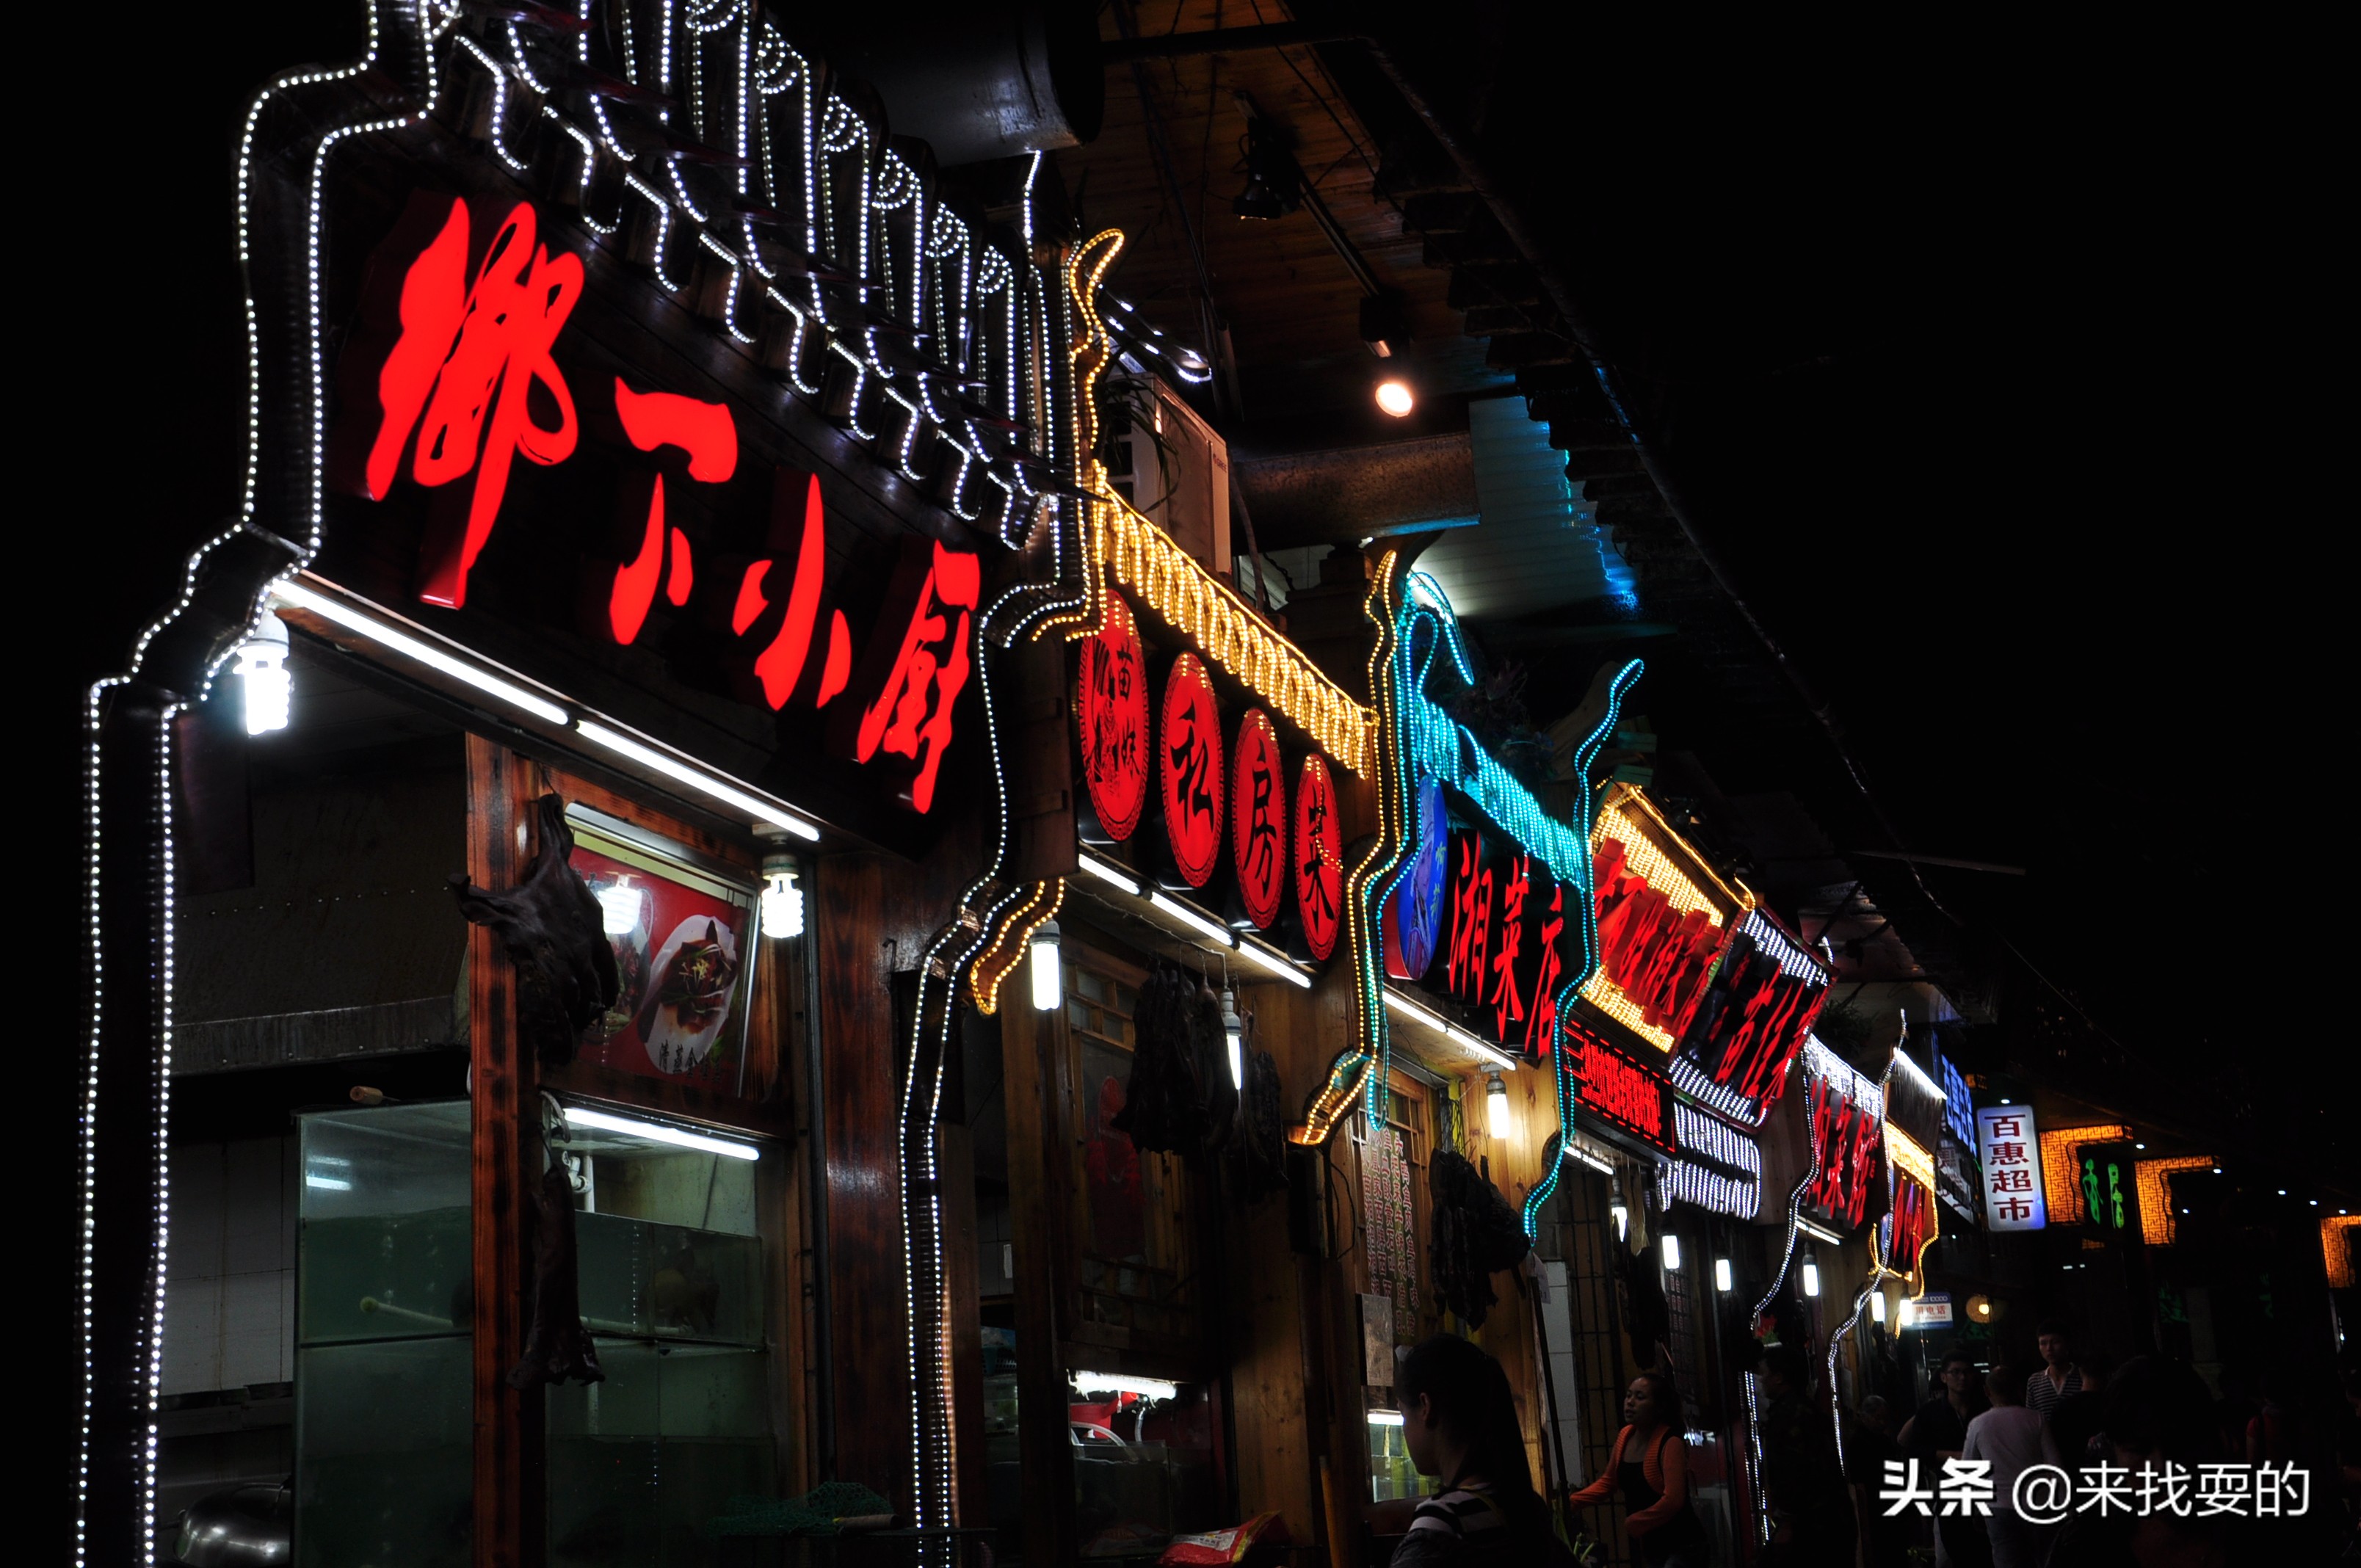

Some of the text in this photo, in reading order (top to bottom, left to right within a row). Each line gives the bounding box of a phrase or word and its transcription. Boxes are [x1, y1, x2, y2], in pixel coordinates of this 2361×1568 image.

[1169, 699, 1334, 932] 私房菜
[1448, 830, 1564, 1058] 湘菜店
[1984, 1114, 2034, 1222] 百惠超市
[1915, 1305, 1946, 1315] 用电话
